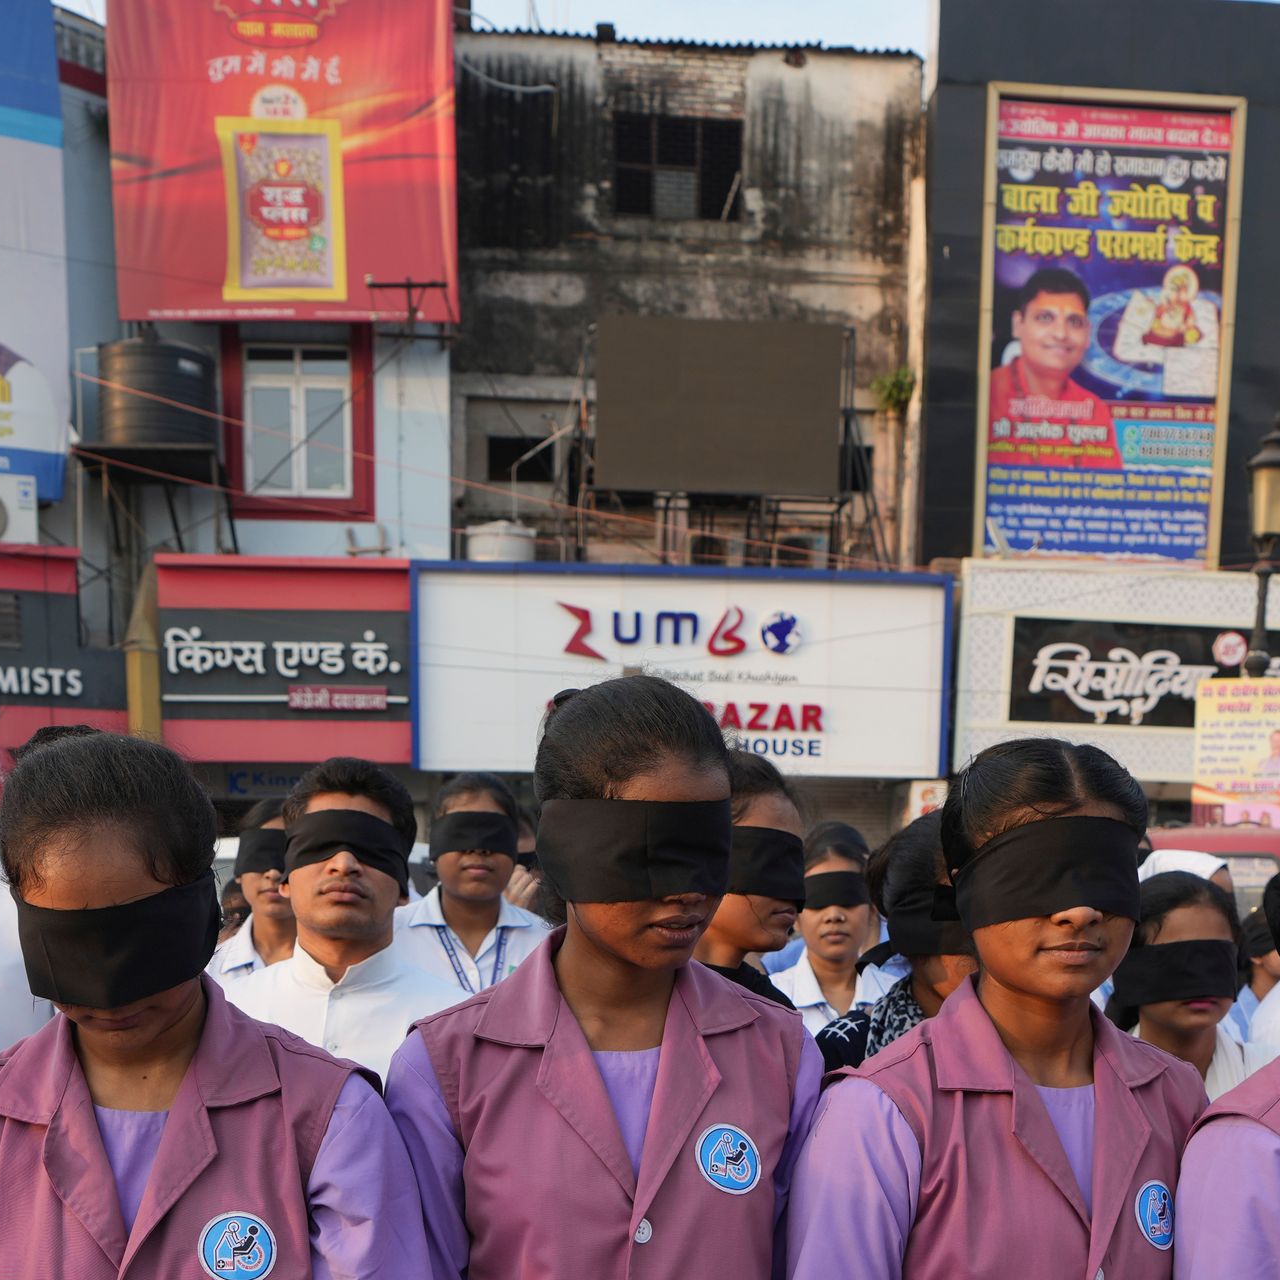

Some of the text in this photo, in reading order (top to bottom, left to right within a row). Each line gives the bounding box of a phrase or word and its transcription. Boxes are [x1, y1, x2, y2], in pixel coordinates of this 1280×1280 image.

[1000, 183, 1061, 215] बाला
[1064, 181, 1100, 217] जी
[1105, 183, 1190, 222] ज्योतिष
[995, 218, 1221, 264] कर्मकाण्ड परामर्श केन्द्र
[164, 626, 402, 678] किंग्स एण्ड कं.
